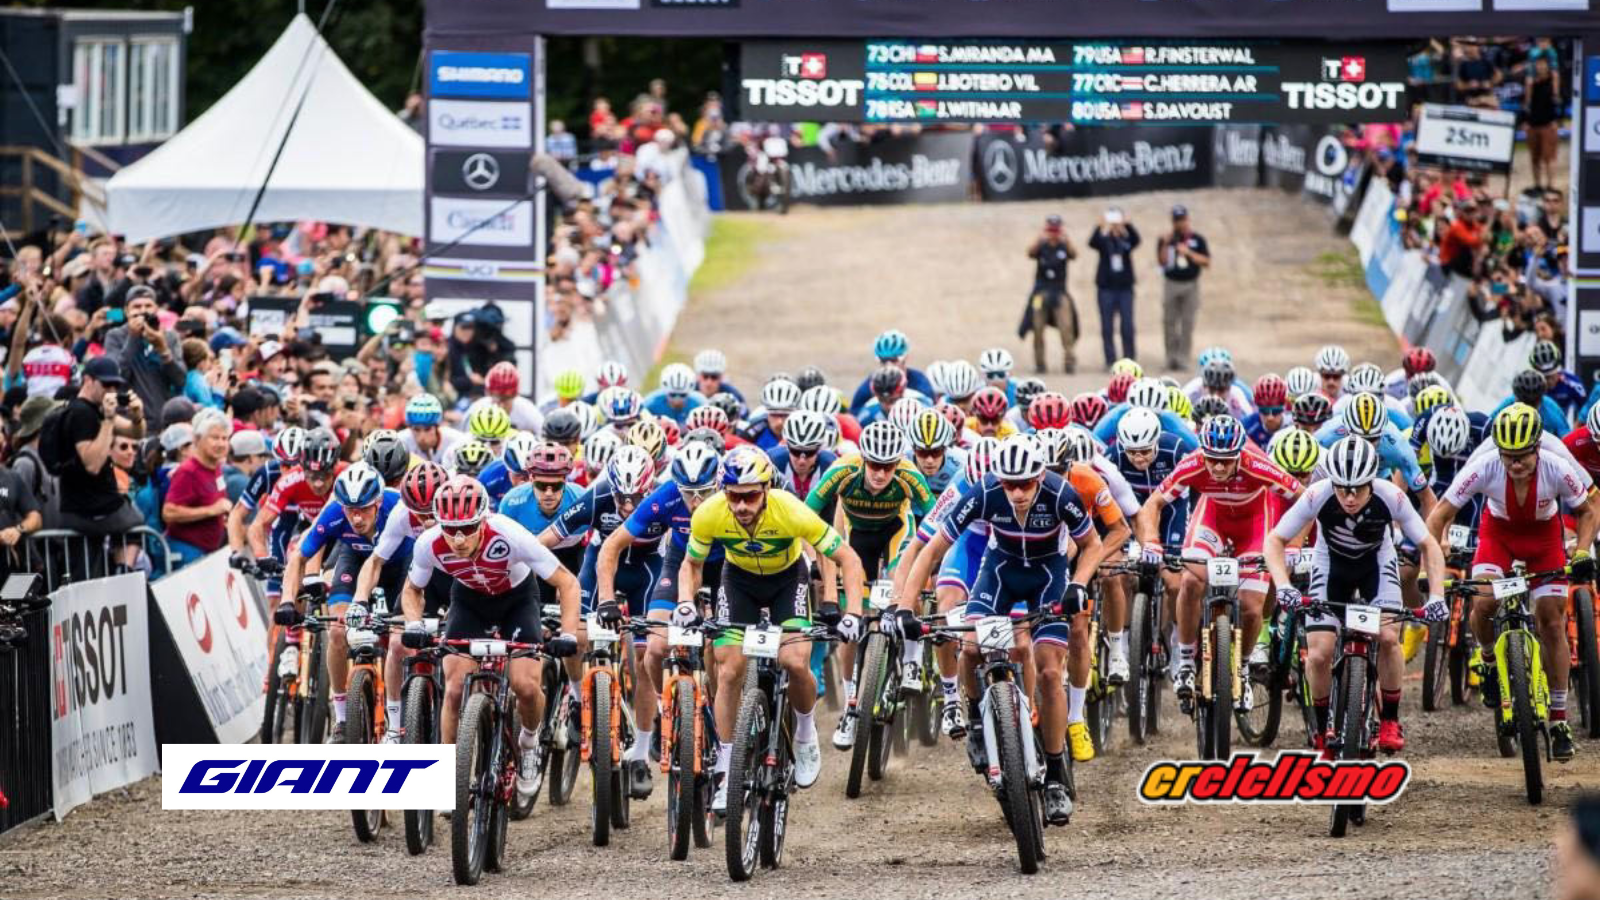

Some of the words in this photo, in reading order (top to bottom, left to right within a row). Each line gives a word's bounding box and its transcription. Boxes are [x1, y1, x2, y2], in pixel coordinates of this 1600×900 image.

[437, 66, 524, 83] SHIMANO
[742, 79, 864, 106] TISSOT
[1281, 82, 1405, 109] TISSOT
[1445, 126, 1490, 147] 25m
[1023, 140, 1196, 183] Mercedes-Benz
[790, 154, 960, 197] Mercedes-Benz
[1215, 564, 1231, 575] 32
[1502, 581, 1518, 590] 24
[757, 634, 767, 645] 3
[990, 626, 1000, 639] 6
[61, 604, 128, 714] TISSOT
